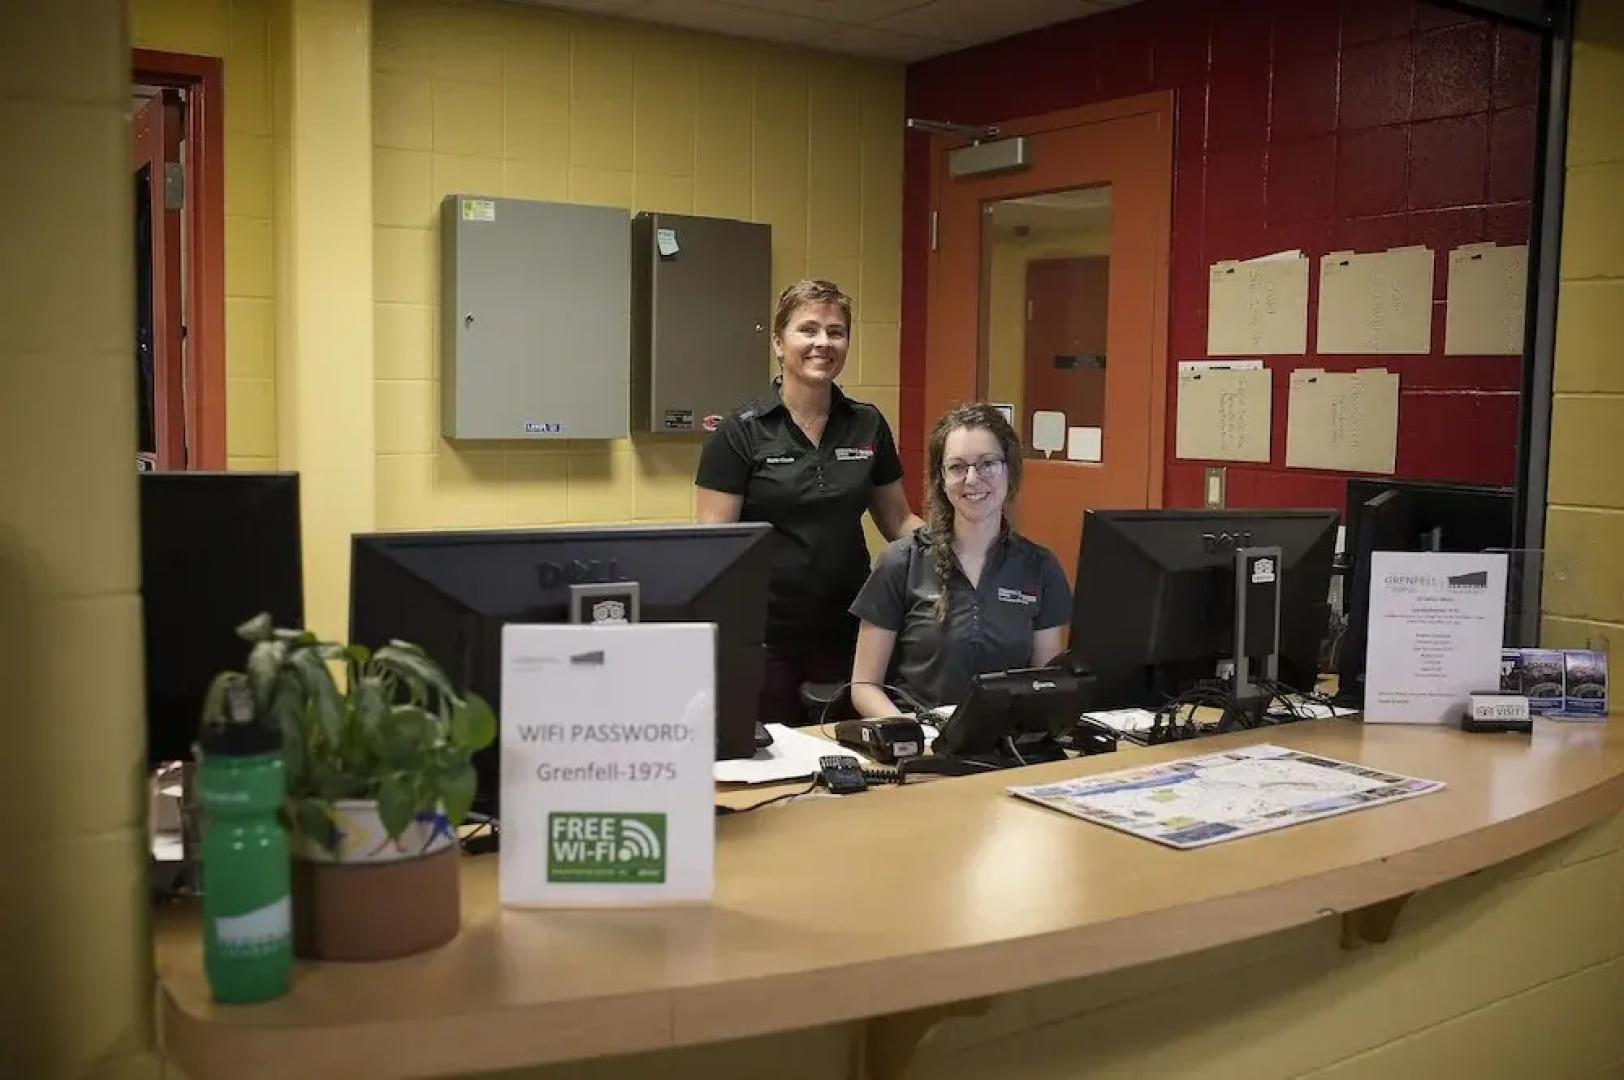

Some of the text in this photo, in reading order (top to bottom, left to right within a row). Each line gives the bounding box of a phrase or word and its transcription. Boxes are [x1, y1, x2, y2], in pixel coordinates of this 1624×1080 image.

[1384, 576, 1438, 586] GRENFELL
[516, 723, 695, 743] WIFI PASSWORD:
[536, 761, 678, 782] Grenfell-1975
[552, 816, 617, 841] FREE
[553, 840, 617, 862] WI-FI
